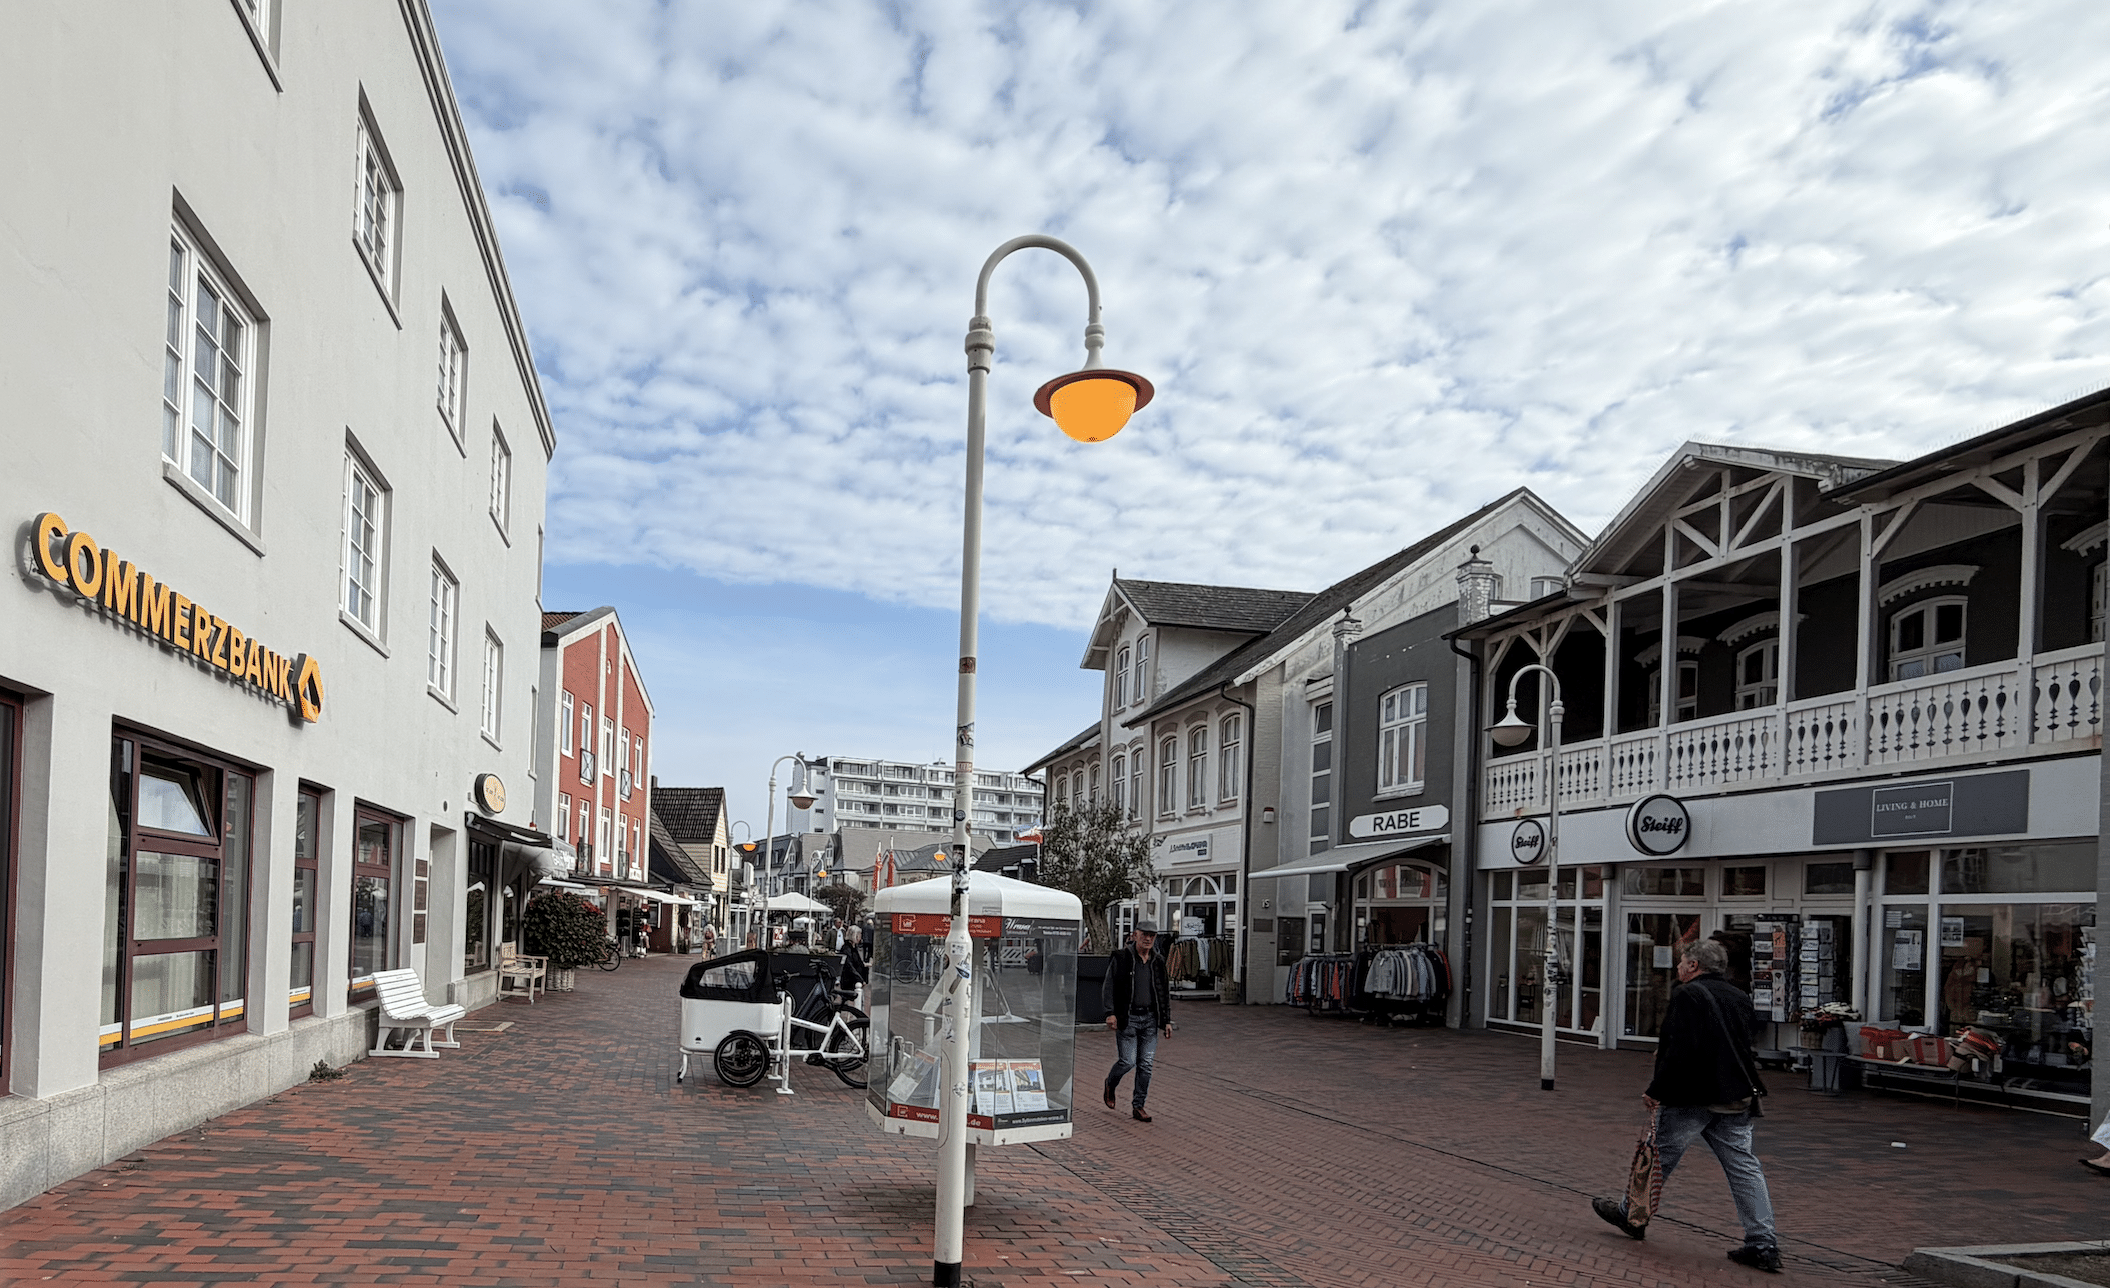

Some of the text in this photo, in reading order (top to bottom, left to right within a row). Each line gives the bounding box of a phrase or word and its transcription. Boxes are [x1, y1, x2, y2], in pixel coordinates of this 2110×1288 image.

[32, 512, 291, 701] COMMERZBANK
[1876, 799, 1948, 812] LIVING & HOME
[1373, 811, 1420, 832] RABE
[1641, 815, 1683, 834] Steiff
[1515, 835, 1539, 848] Steiff
